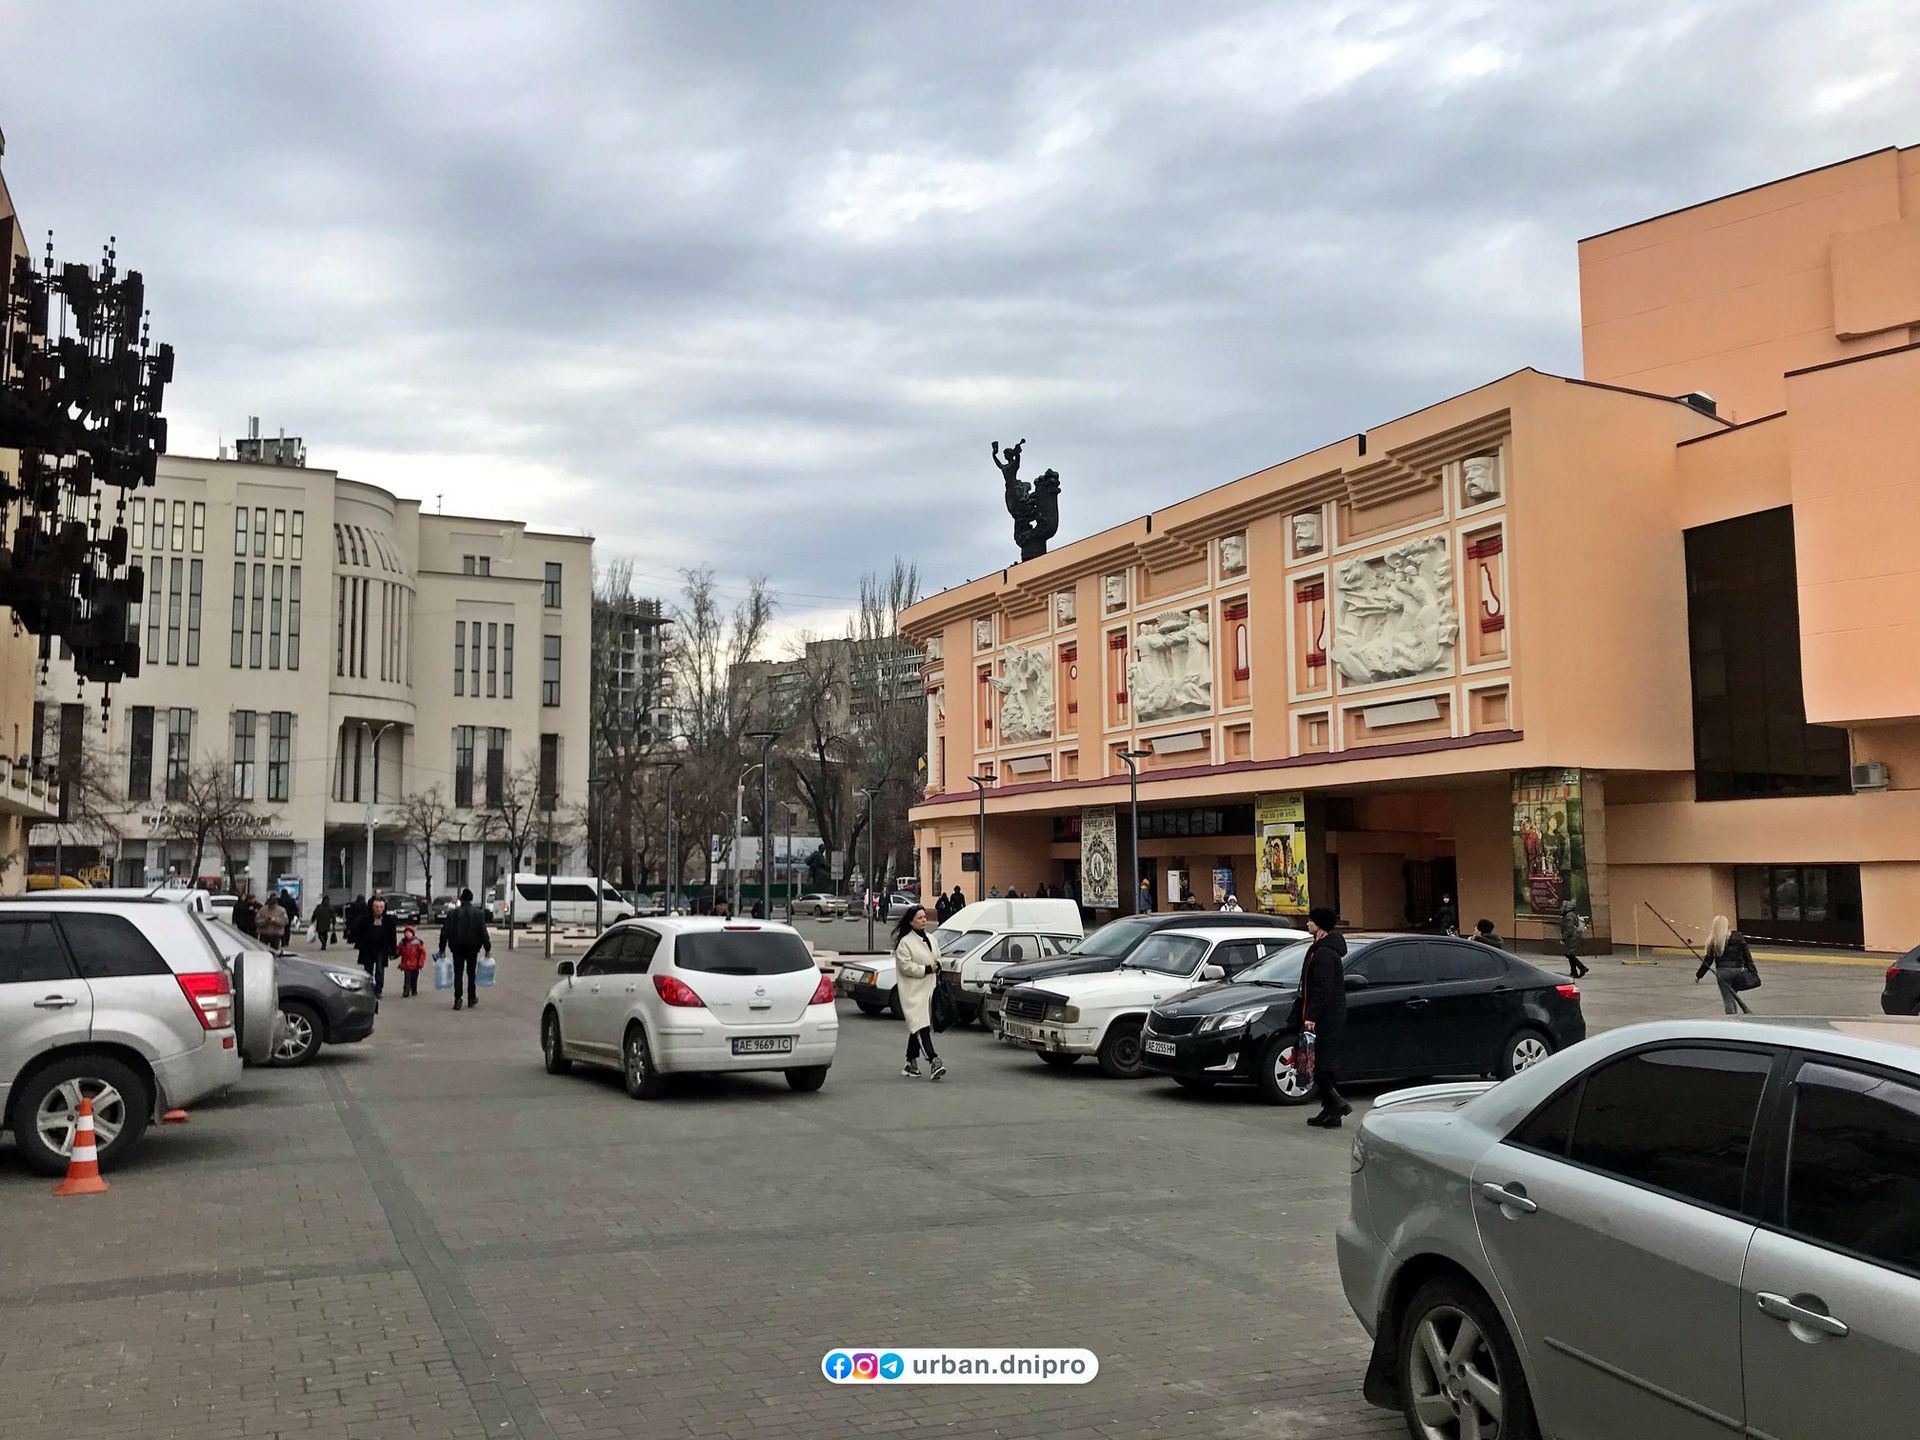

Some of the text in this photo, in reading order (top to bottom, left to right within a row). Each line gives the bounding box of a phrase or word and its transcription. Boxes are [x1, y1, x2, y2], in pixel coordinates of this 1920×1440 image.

[739, 1039, 789, 1050] AE 9669 IC
